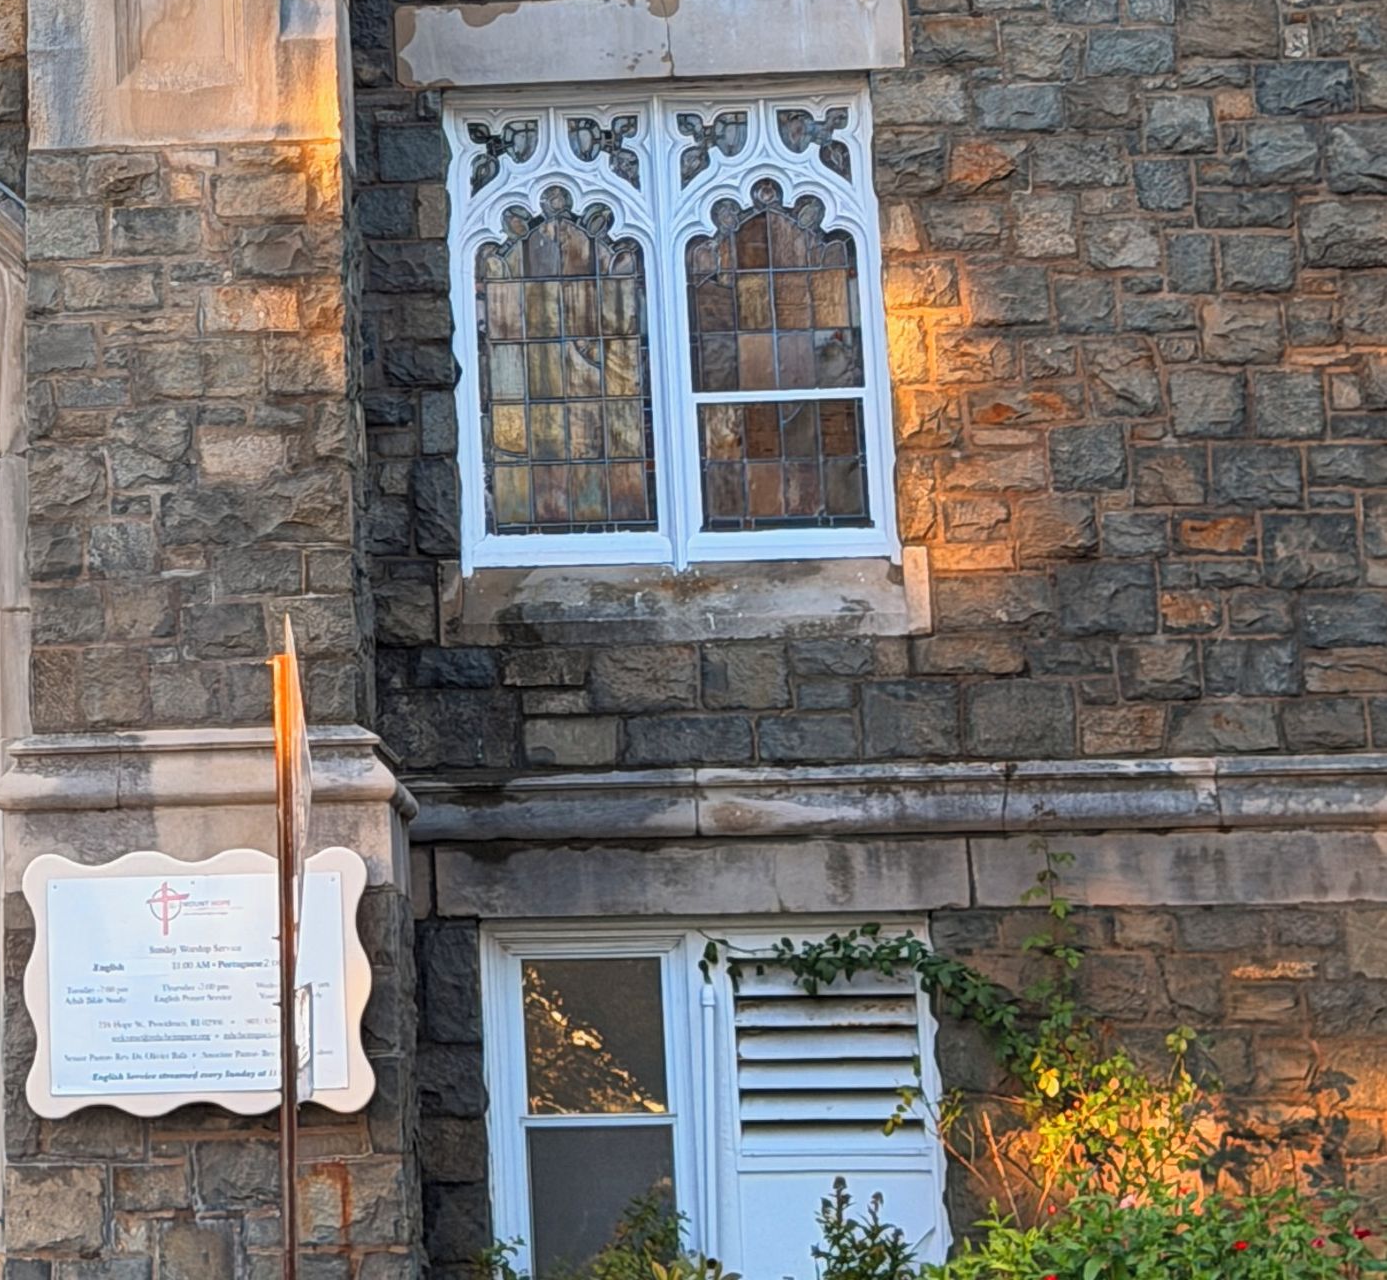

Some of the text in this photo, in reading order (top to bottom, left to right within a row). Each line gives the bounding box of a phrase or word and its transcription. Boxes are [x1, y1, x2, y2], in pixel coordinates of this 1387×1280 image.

[149, 944, 242, 955] Sunday Worship Service
[92, 962, 125, 974] English
[196, 961, 210, 969] AM
[91, 1072, 123, 1083] English
